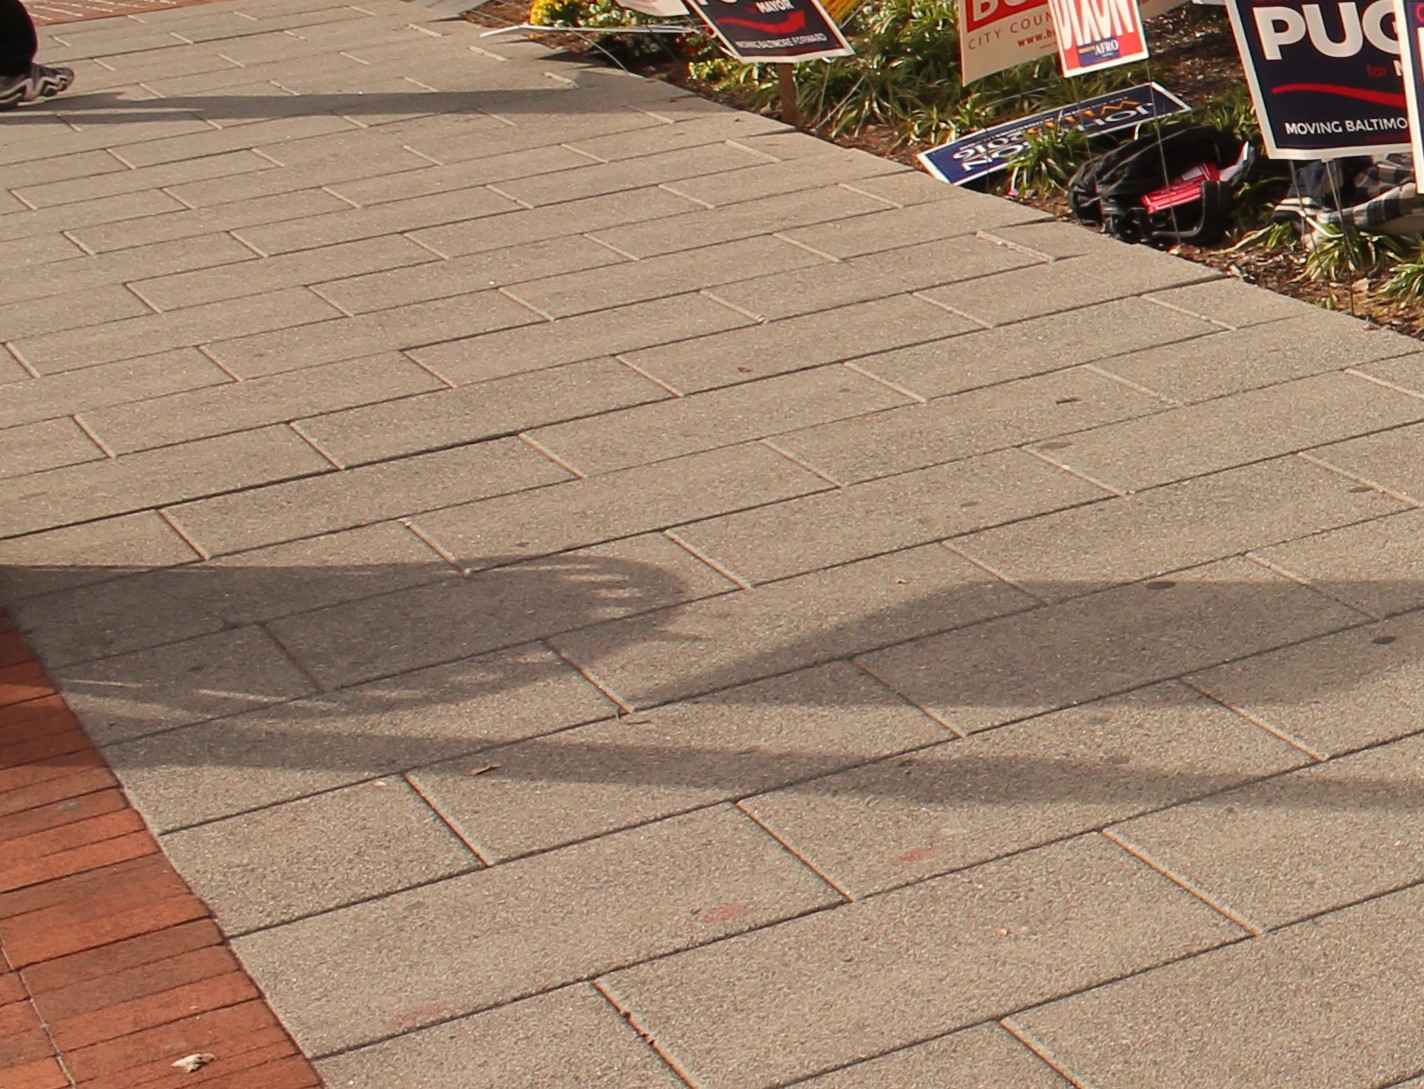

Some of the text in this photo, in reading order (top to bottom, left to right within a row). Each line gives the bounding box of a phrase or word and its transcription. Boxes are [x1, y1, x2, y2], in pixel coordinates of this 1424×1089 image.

[968, 28, 1002, 50] CITY
[1094, 39, 1120, 56] AFRO
[1366, 63, 1387, 78] for
[1284, 121, 1343, 136] MOVING
